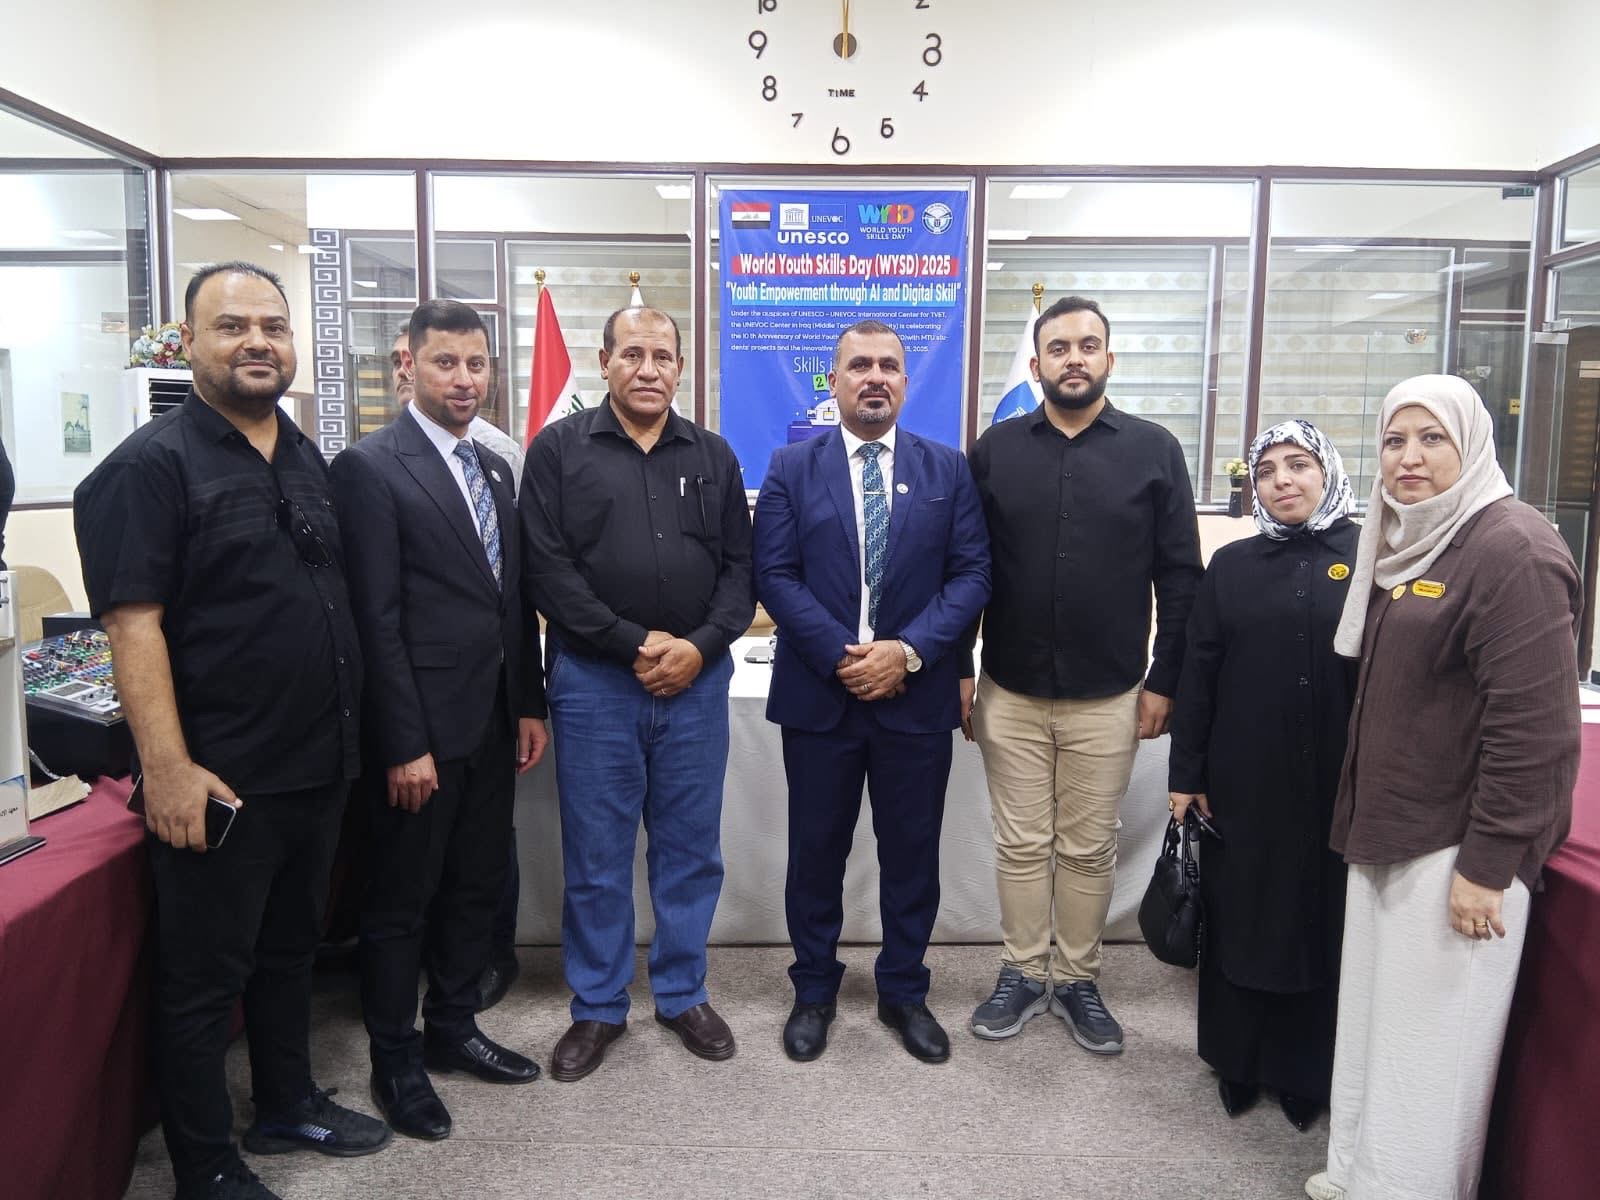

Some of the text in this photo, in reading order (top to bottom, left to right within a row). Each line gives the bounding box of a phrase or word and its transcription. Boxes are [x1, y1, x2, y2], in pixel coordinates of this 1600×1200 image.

[748, 30, 768, 59] 9
[762, 75, 778, 102] 8
[828, 88, 856, 98] TIME
[912, 80, 929, 102] 4
[791, 112, 804, 128] 7
[880, 117, 895, 139] 5
[831, 126, 850, 155] 6
[777, 231, 850, 245] unesco
[887, 226, 913, 234] YOUTH
[740, 252, 951, 281] World Youth Skills Day (WYSD) 2025
[760, 282, 828, 305] Empowerment
[830, 281, 868, 305] through
[870, 283, 880, 302] AI
[882, 283, 900, 302] and
[902, 283, 933, 306] Digital
[830, 311, 857, 319] UNEVOC
[906, 323, 942, 331] celebrating
[750, 344, 776, 352] projects
[793, 355, 826, 374] Skills
[815, 376, 825, 388] 2
